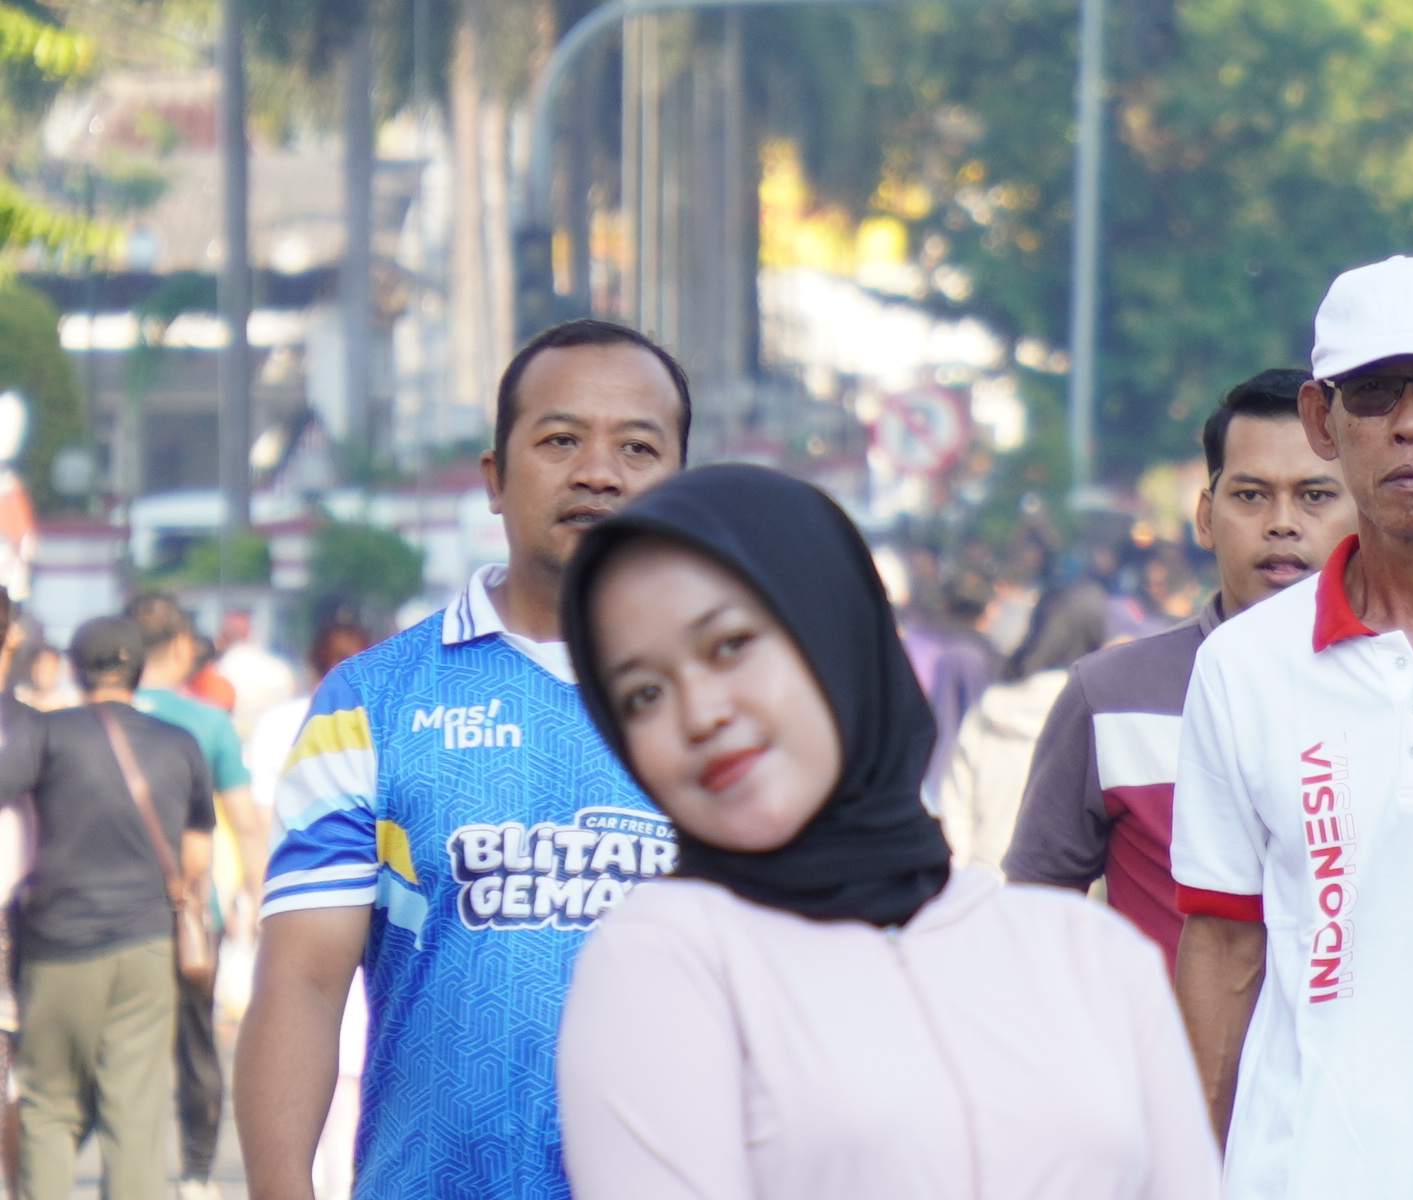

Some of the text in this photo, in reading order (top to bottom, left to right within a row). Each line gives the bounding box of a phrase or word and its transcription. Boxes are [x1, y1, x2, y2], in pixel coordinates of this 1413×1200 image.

[585, 816, 679, 839] CAR FREE DA
[469, 874, 628, 920] GEMA
